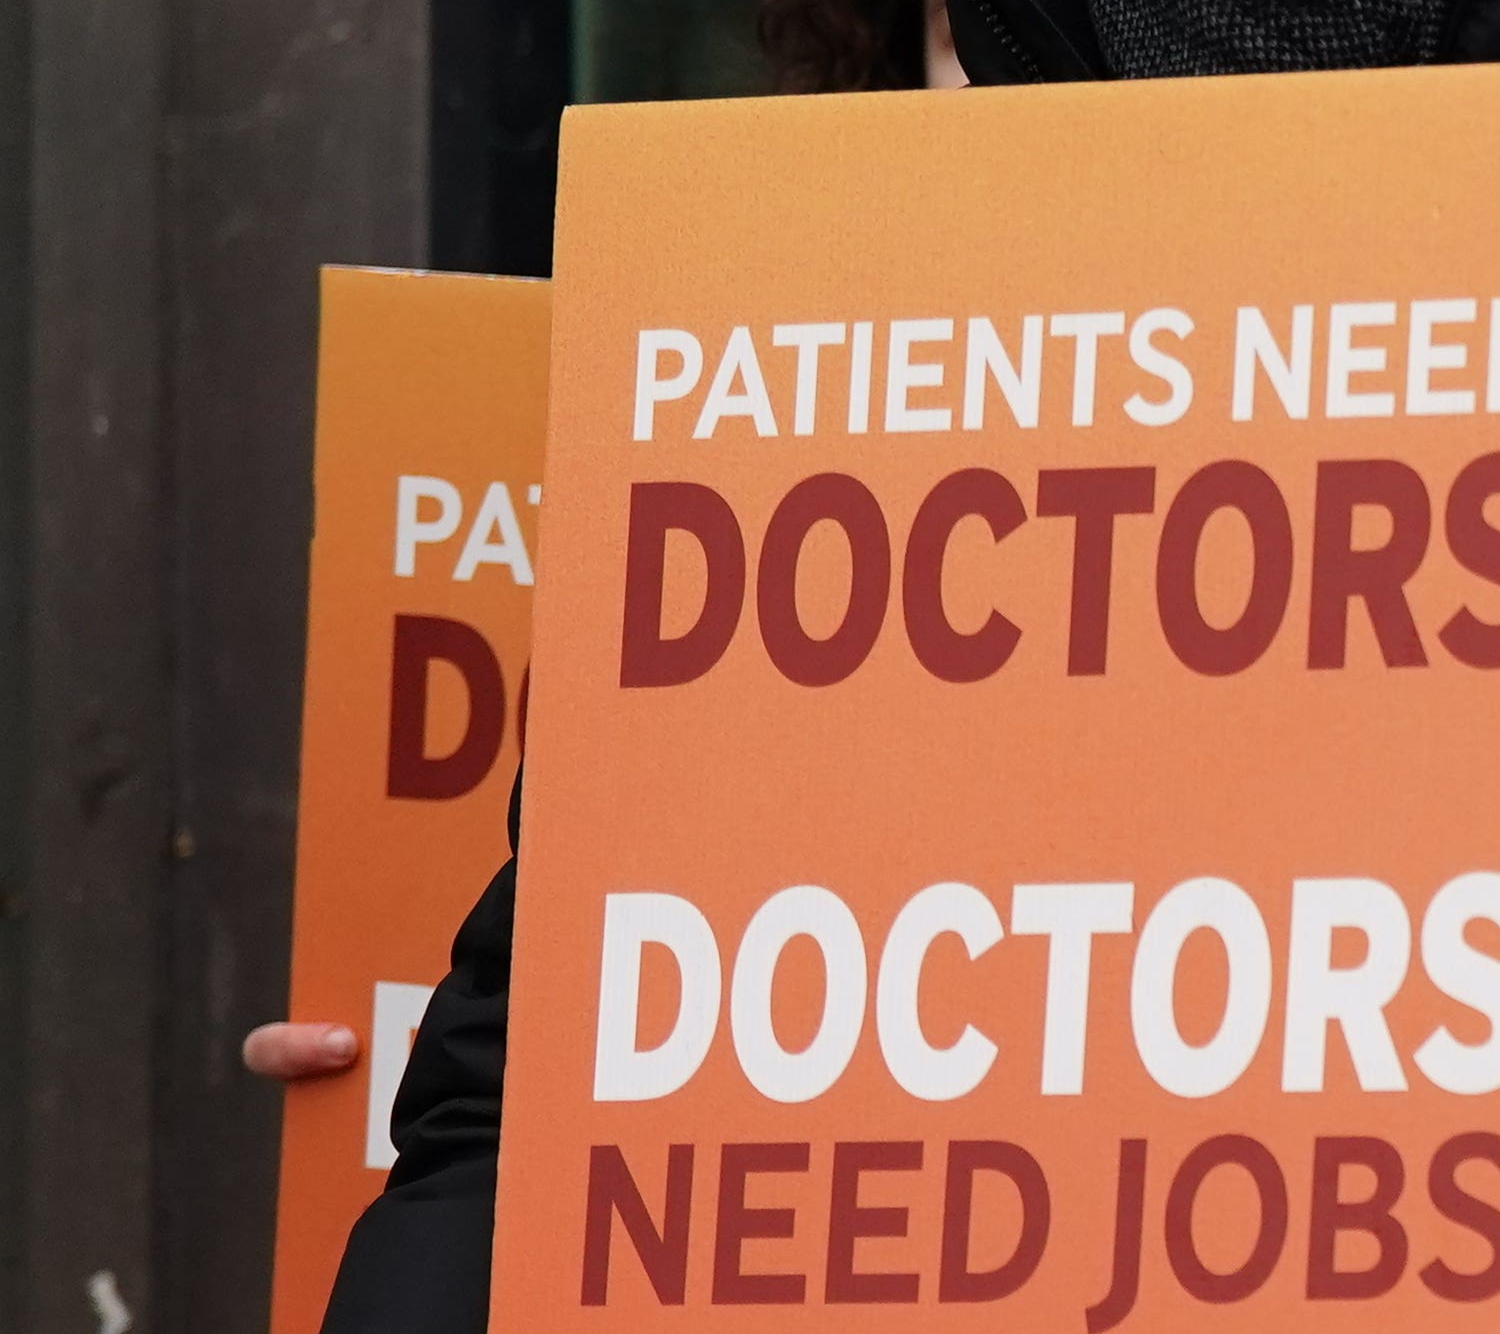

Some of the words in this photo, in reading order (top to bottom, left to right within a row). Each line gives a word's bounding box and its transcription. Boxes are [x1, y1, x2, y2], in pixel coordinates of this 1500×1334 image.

[632, 307, 1195, 441] PATIENTS
[393, 475, 542, 586] PA
[580, 1139, 1051, 1307] NEED
